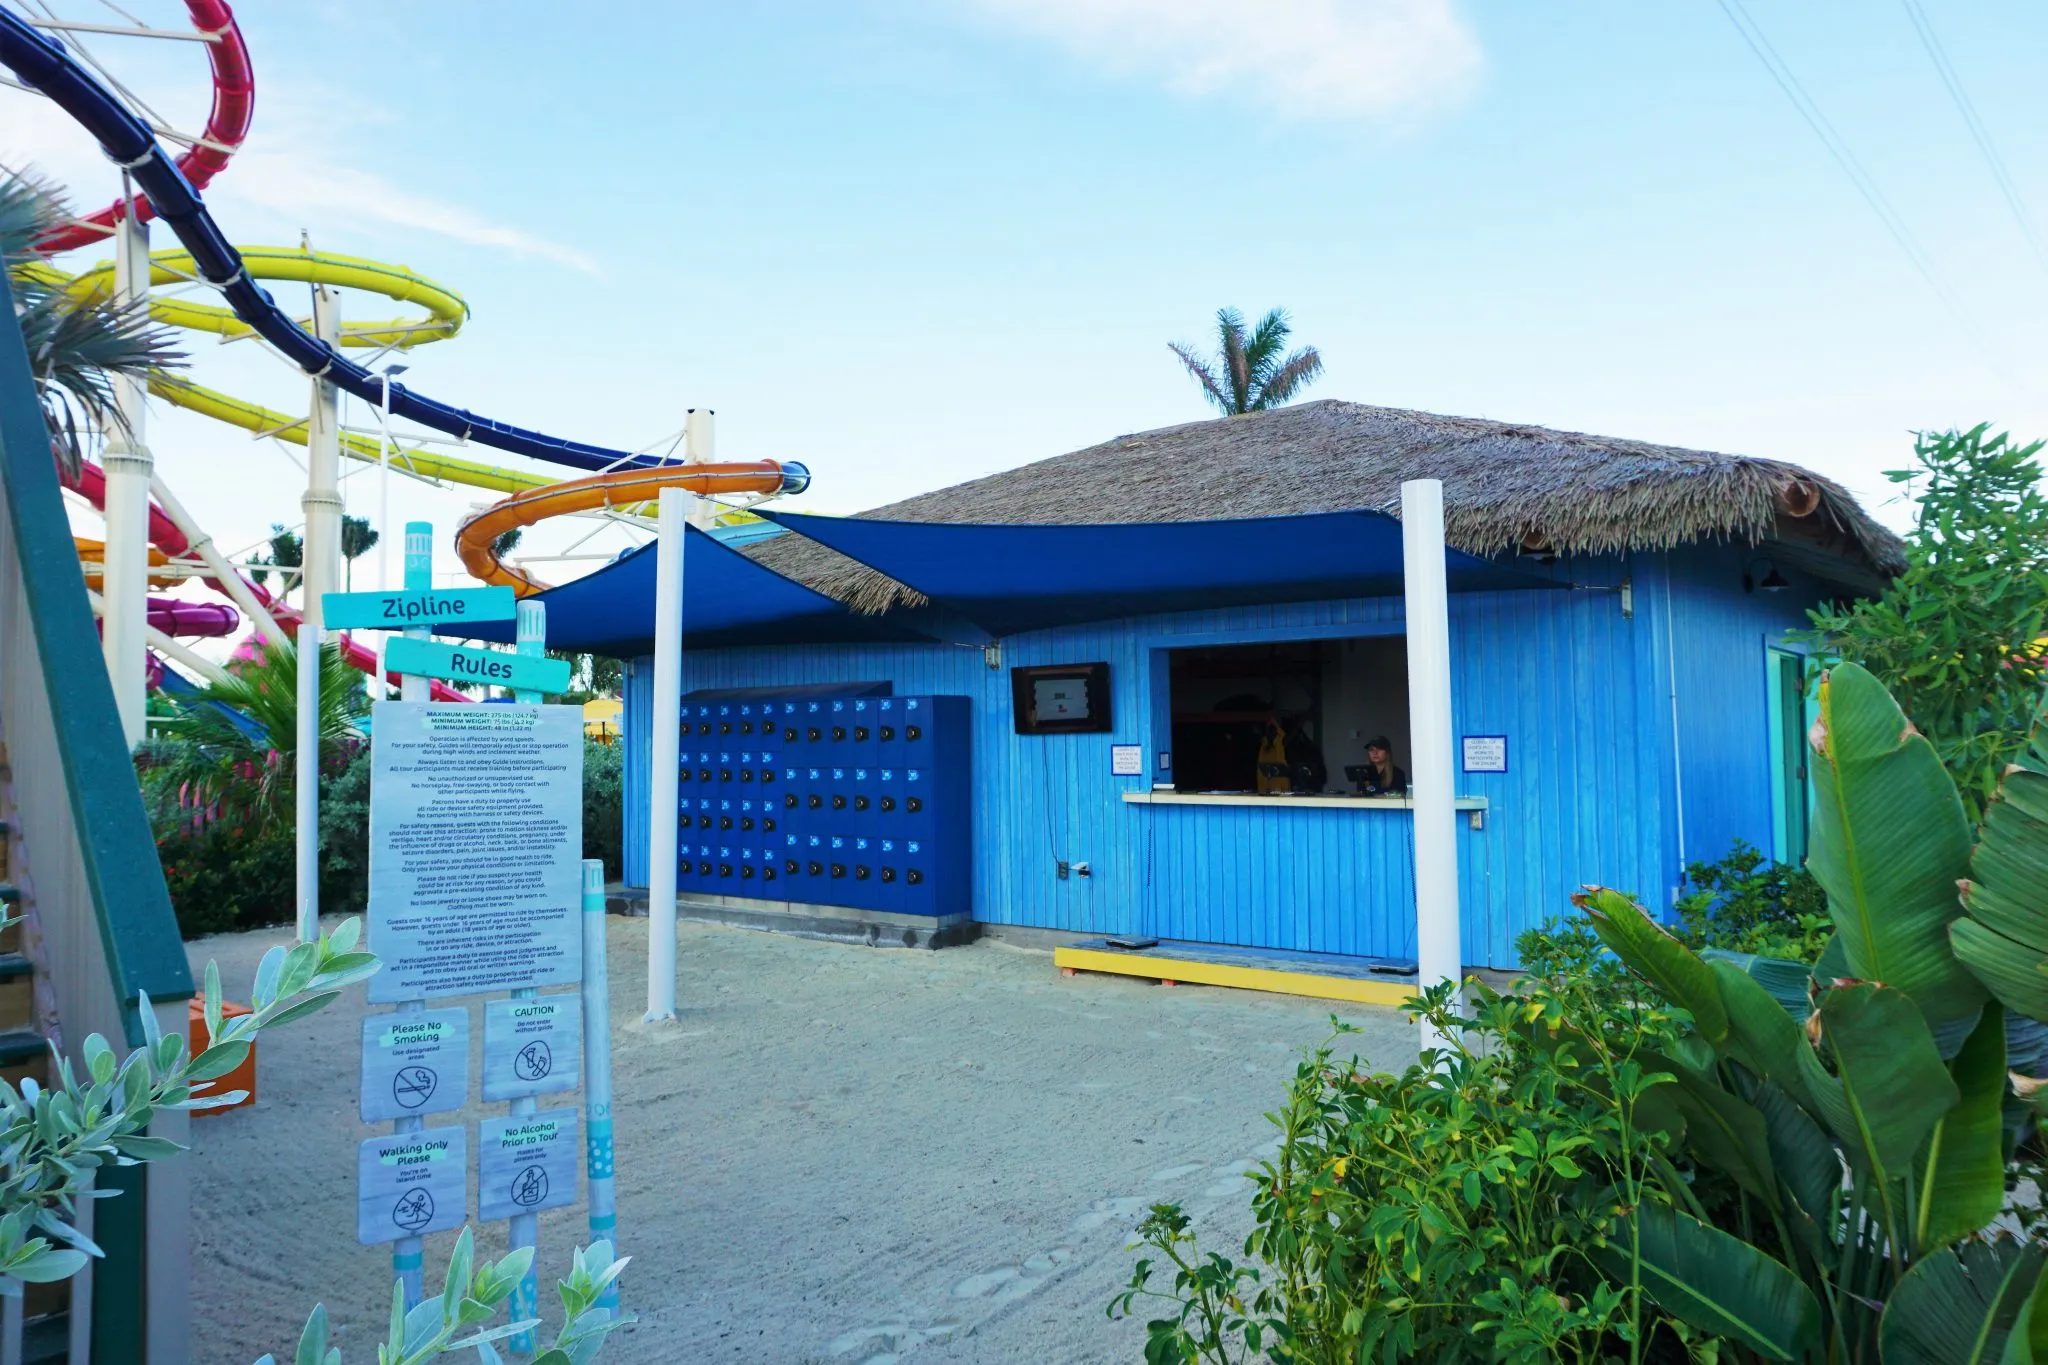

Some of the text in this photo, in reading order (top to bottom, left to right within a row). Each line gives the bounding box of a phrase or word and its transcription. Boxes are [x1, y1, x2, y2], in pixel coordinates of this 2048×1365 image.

[382, 596, 465, 621] Zipline
[451, 653, 513, 678] Rules
[426, 811, 457, 819] tampering
[453, 833, 485, 841] circulatory
[401, 866, 415, 874] Only
[460, 862, 484, 870] physical
[413, 888, 442, 896] aggravate
[447, 902, 472, 911] Clothing
[421, 922, 441, 930] guests
[527, 912, 564, 922] accompanied
[504, 930, 541, 939] participation
[442, 966, 457, 974] obey
[515, 1005, 554, 1017] CAUTION
[392, 1022, 442, 1034] Please No
[394, 1033, 439, 1044] Smoking
[406, 1045, 440, 1054] designated
[505, 1122, 555, 1136] No Alcohol
[502, 1132, 558, 1148] Prior to Tour
[379, 1140, 448, 1158] Walking Only
[398, 1154, 430, 1165] Please
